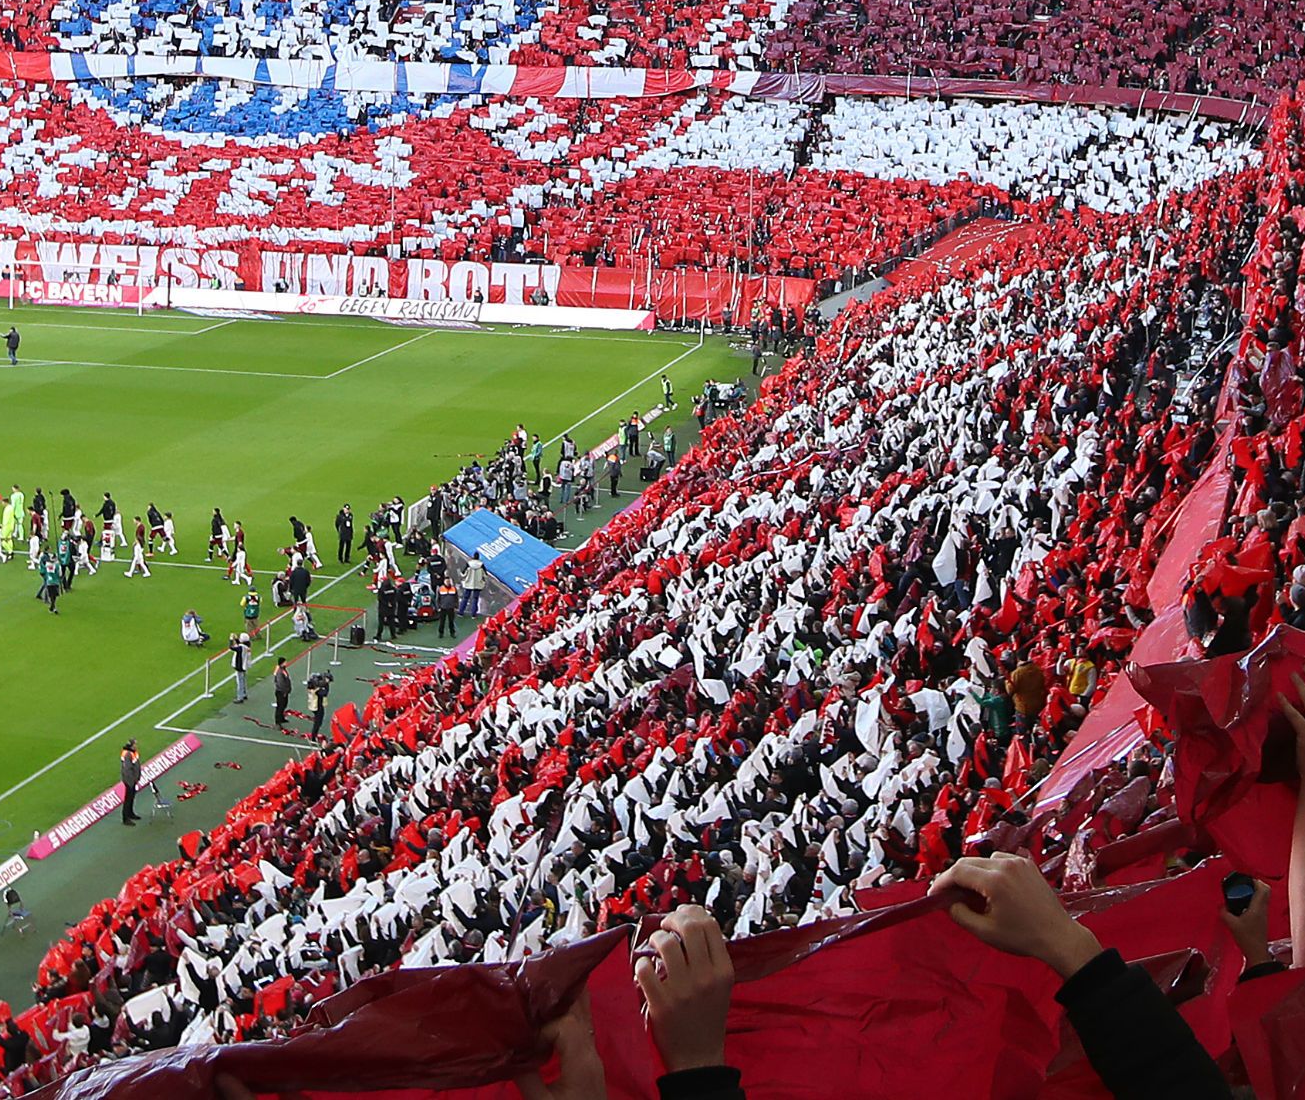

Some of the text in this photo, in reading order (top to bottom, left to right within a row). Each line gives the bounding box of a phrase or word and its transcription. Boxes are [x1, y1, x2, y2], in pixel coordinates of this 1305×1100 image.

[36, 241, 239, 291] WEISS
[262, 251, 390, 299] UND
[407, 258, 561, 307] ROT!
[47, 282, 123, 303] BAYERN
[339, 298, 392, 316] GEGEN
[398, 300, 482, 322] RASSISMUS
[476, 534, 512, 561] Allianz
[164, 740, 192, 765] SPORT
[56, 790, 122, 843] MAGENTA SPORT
